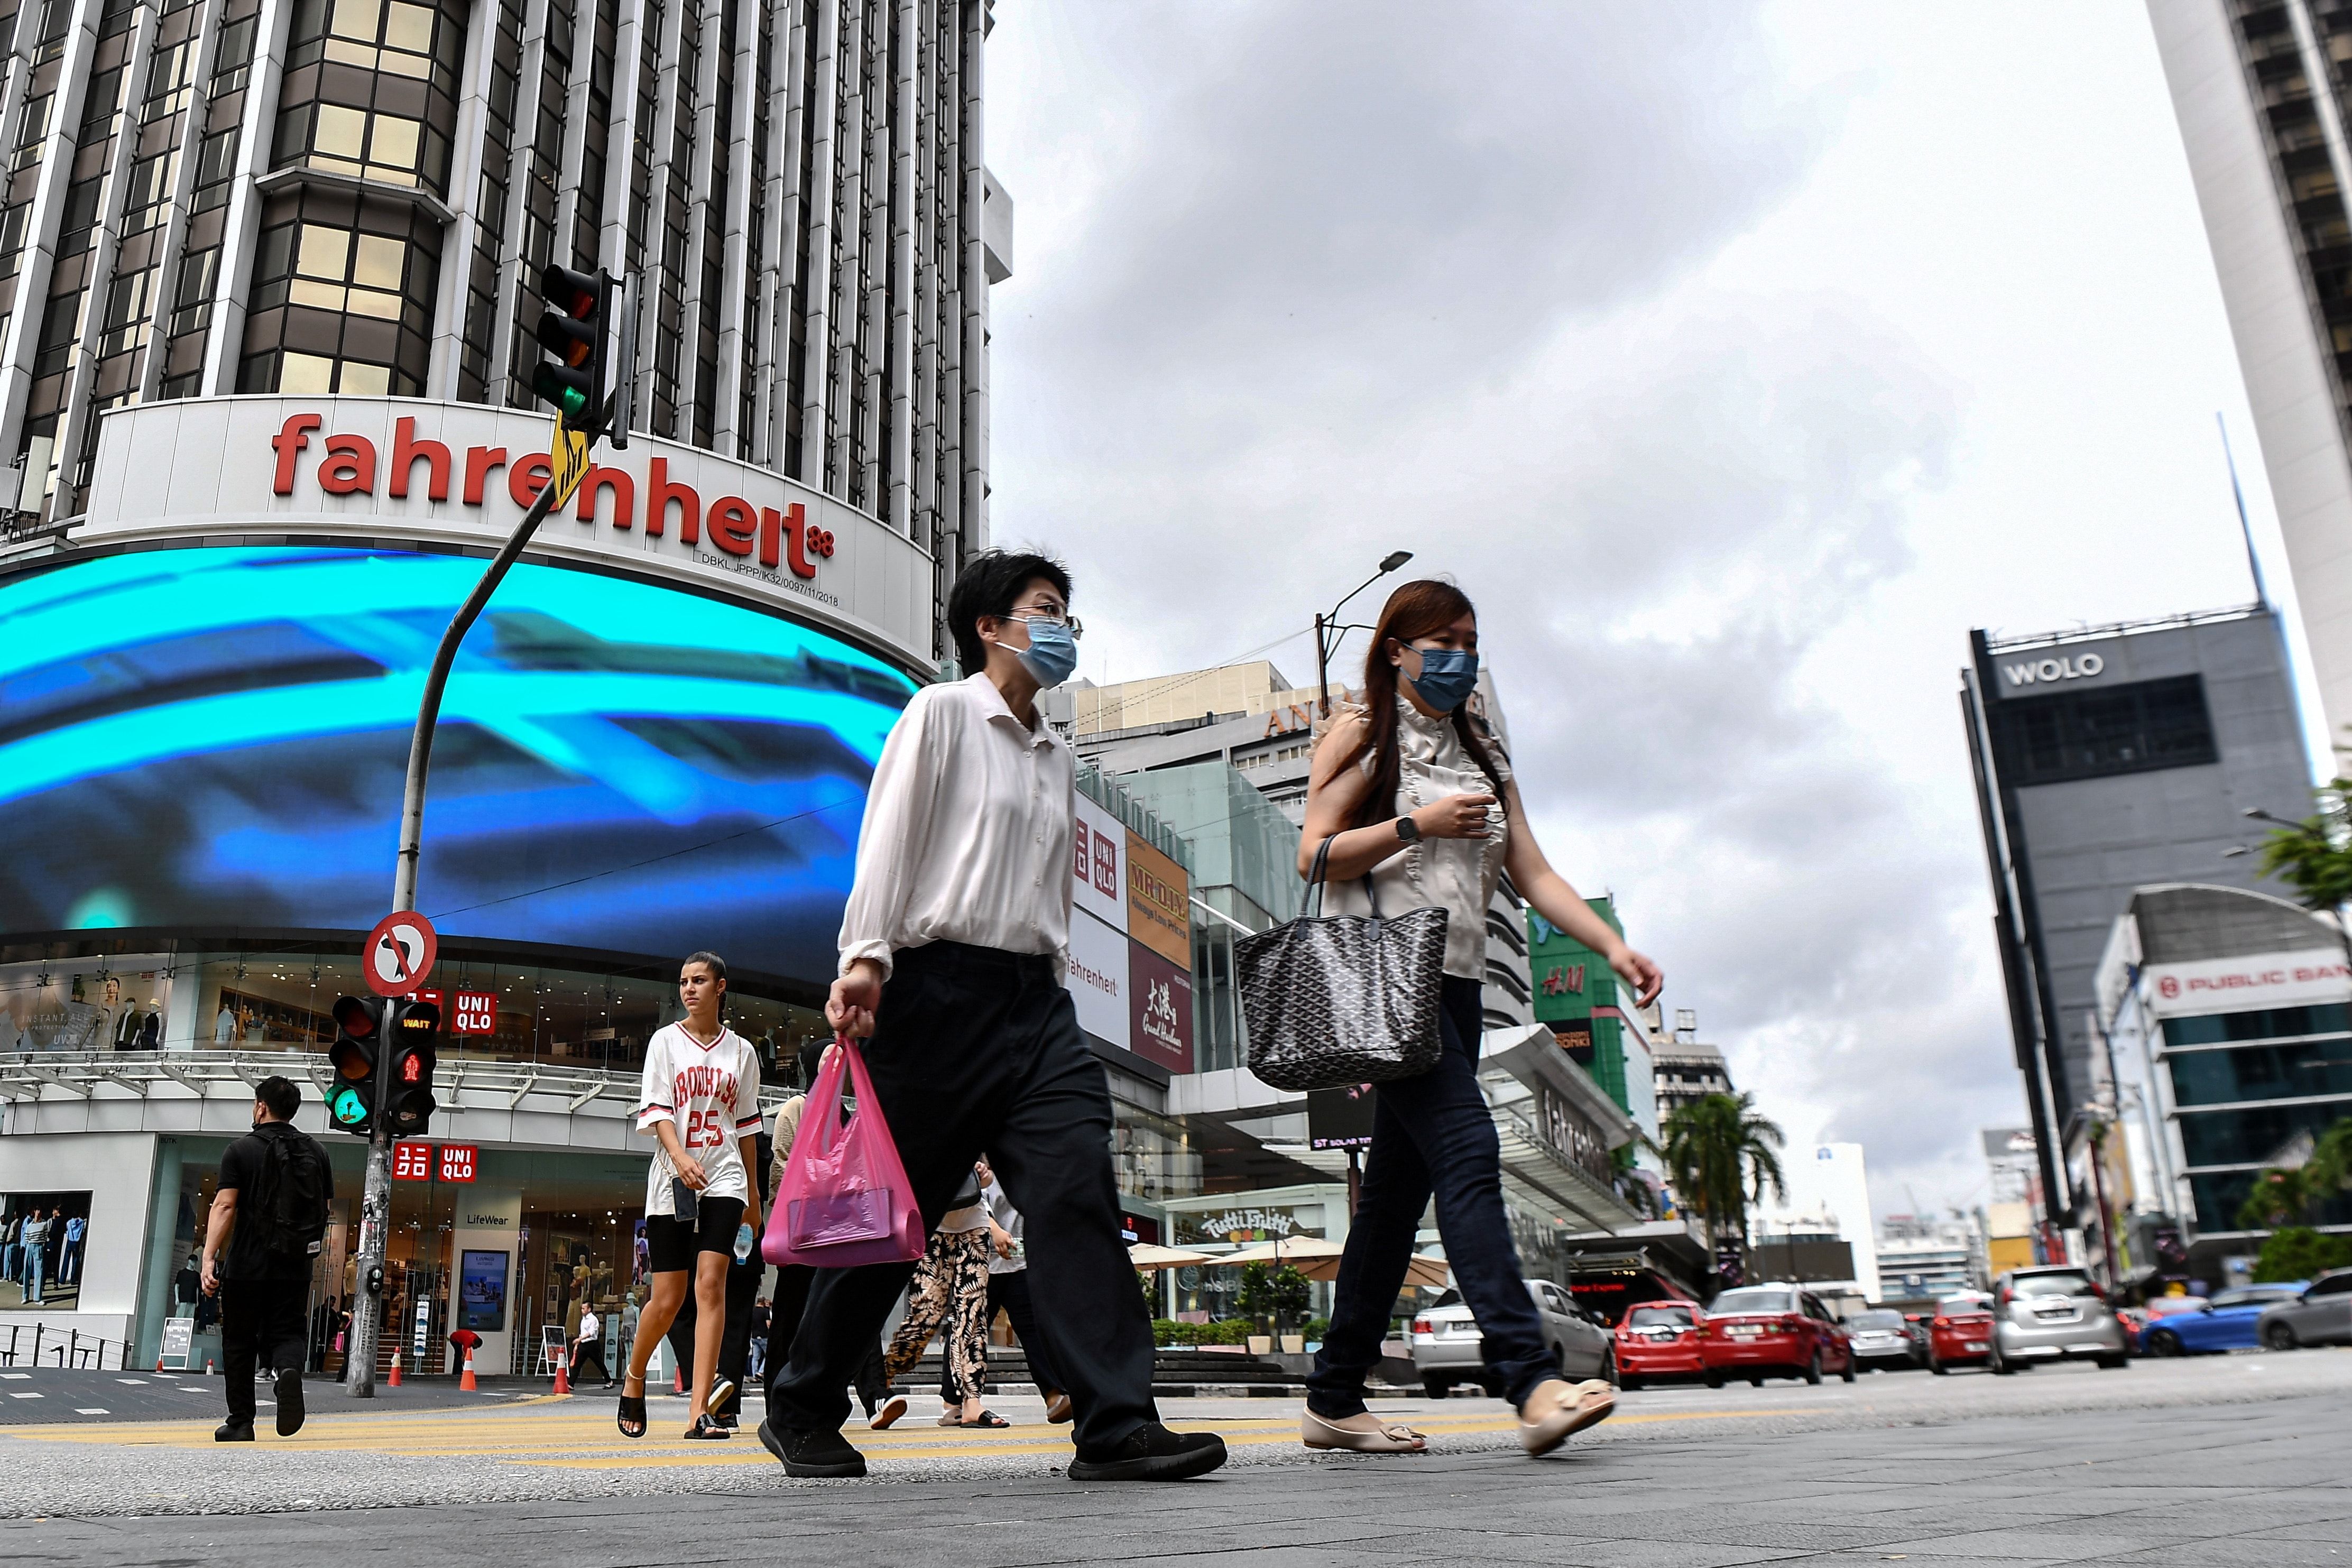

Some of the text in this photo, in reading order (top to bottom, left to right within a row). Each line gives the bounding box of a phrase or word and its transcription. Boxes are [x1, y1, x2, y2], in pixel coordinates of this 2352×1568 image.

[272, 413, 816, 579] fahrenheit
[2003, 652, 2104, 686] WOLO
[1095, 838, 1112, 868] UNI
[1095, 864, 1115, 892] QLO
[1066, 953, 1118, 998] fahrenheit
[1542, 964, 1585, 995] H&M
[2188, 970, 2286, 992] PUBLIC
[458, 995, 490, 1012] UNI
[403, 1018, 430, 1029] WAIT
[457, 1012, 491, 1031] QLO
[686, 1110, 724, 1148] 25
[444, 1149, 471, 1163] UNI
[443, 1164, 472, 1179] QLO
[467, 1214, 509, 1225] LifeWear
